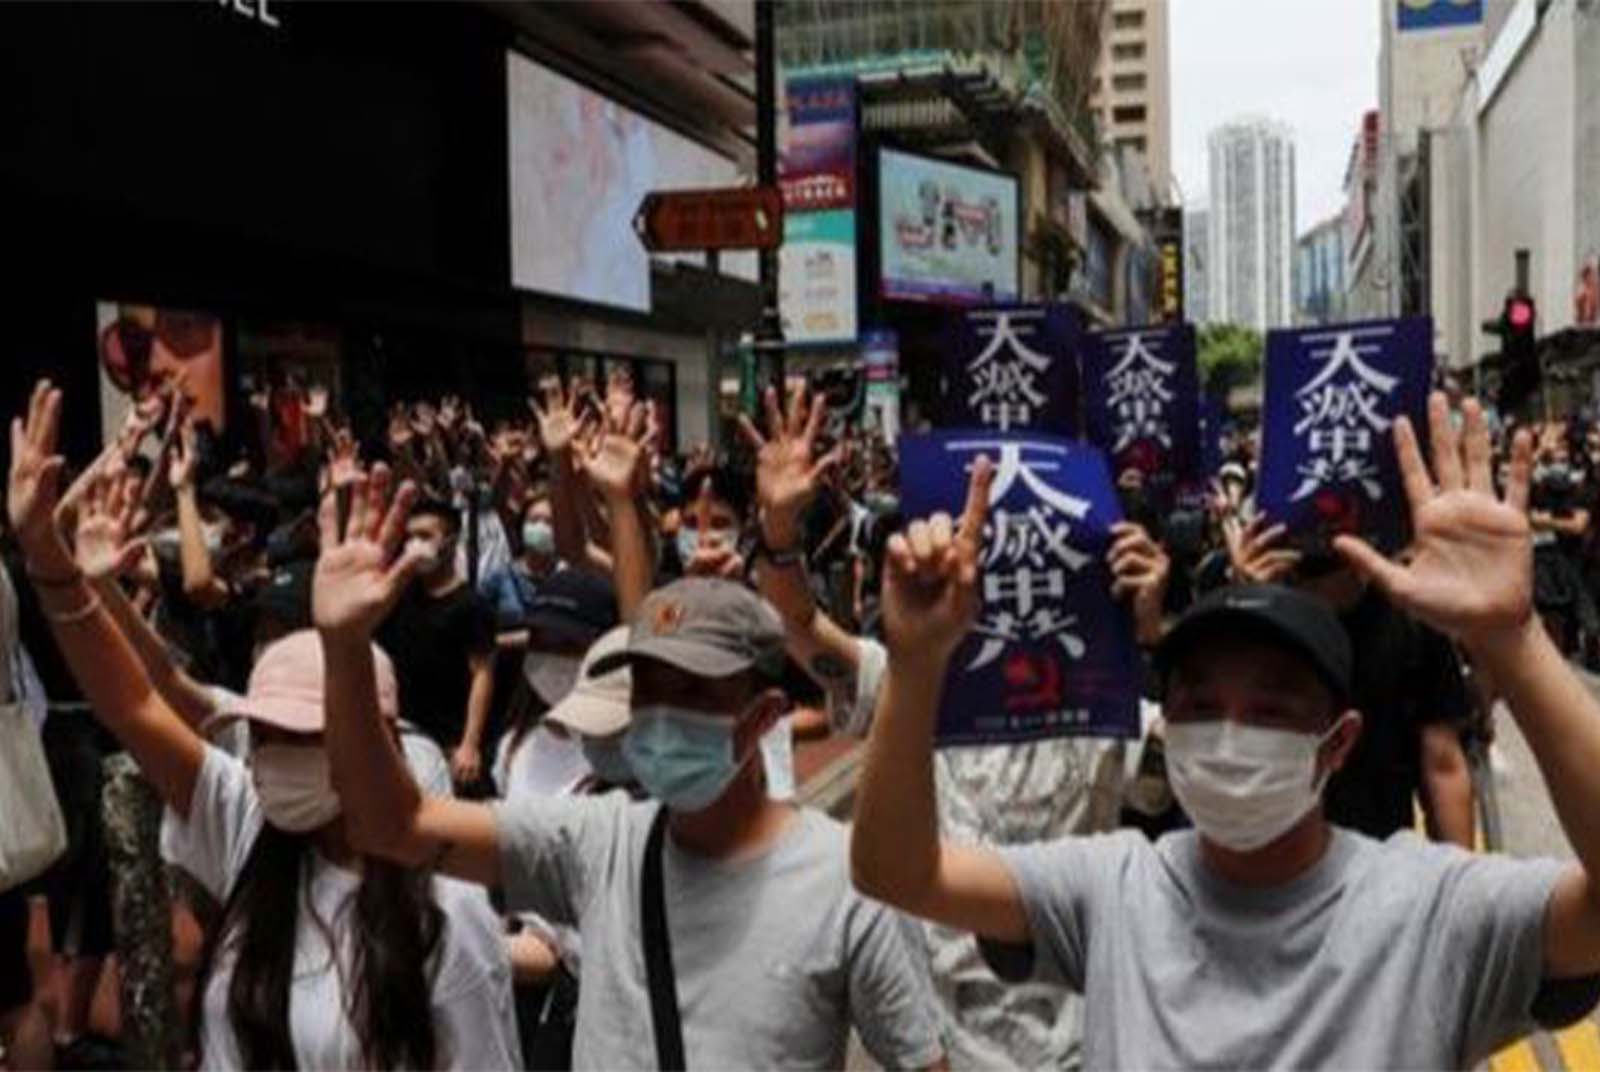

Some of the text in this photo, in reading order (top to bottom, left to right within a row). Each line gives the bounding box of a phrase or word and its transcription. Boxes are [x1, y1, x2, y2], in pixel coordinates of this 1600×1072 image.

[1289, 325, 1400, 501] 天滅中共
[946, 440, 1092, 671] 天滅中共
